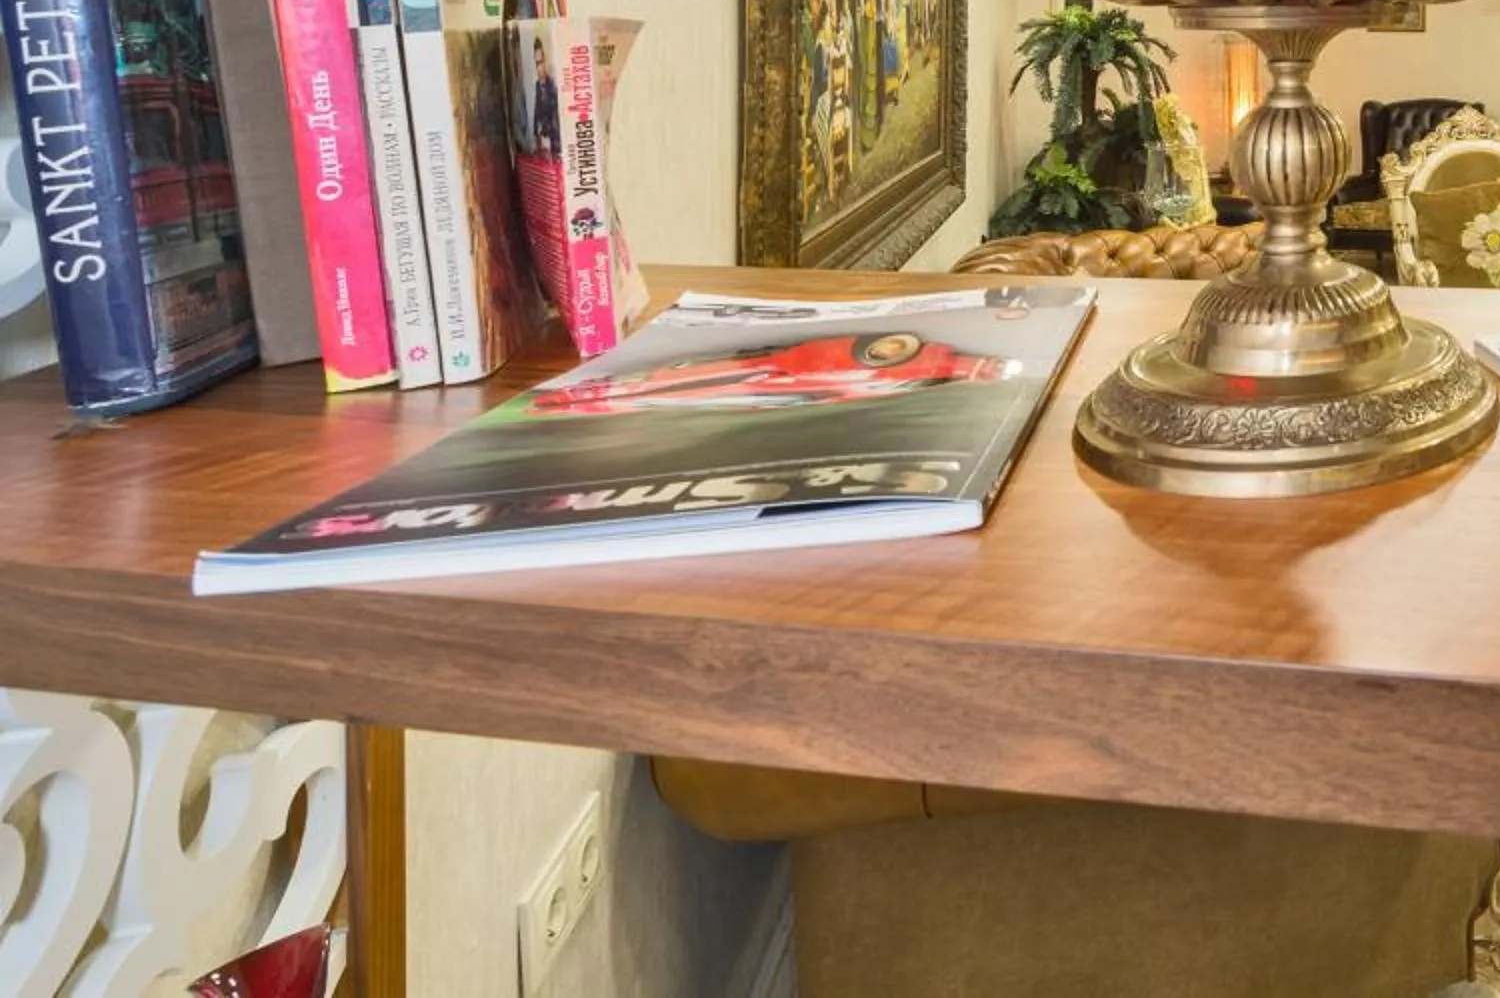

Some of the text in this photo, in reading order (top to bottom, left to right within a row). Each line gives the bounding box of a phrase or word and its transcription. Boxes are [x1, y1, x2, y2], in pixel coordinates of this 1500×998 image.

[308, 69, 344, 202] Один День
[384, 132, 405, 193] ВОЛНАМ
[567, 44, 598, 198] Устинова Астахов
[33, 114, 107, 285] SANKT
